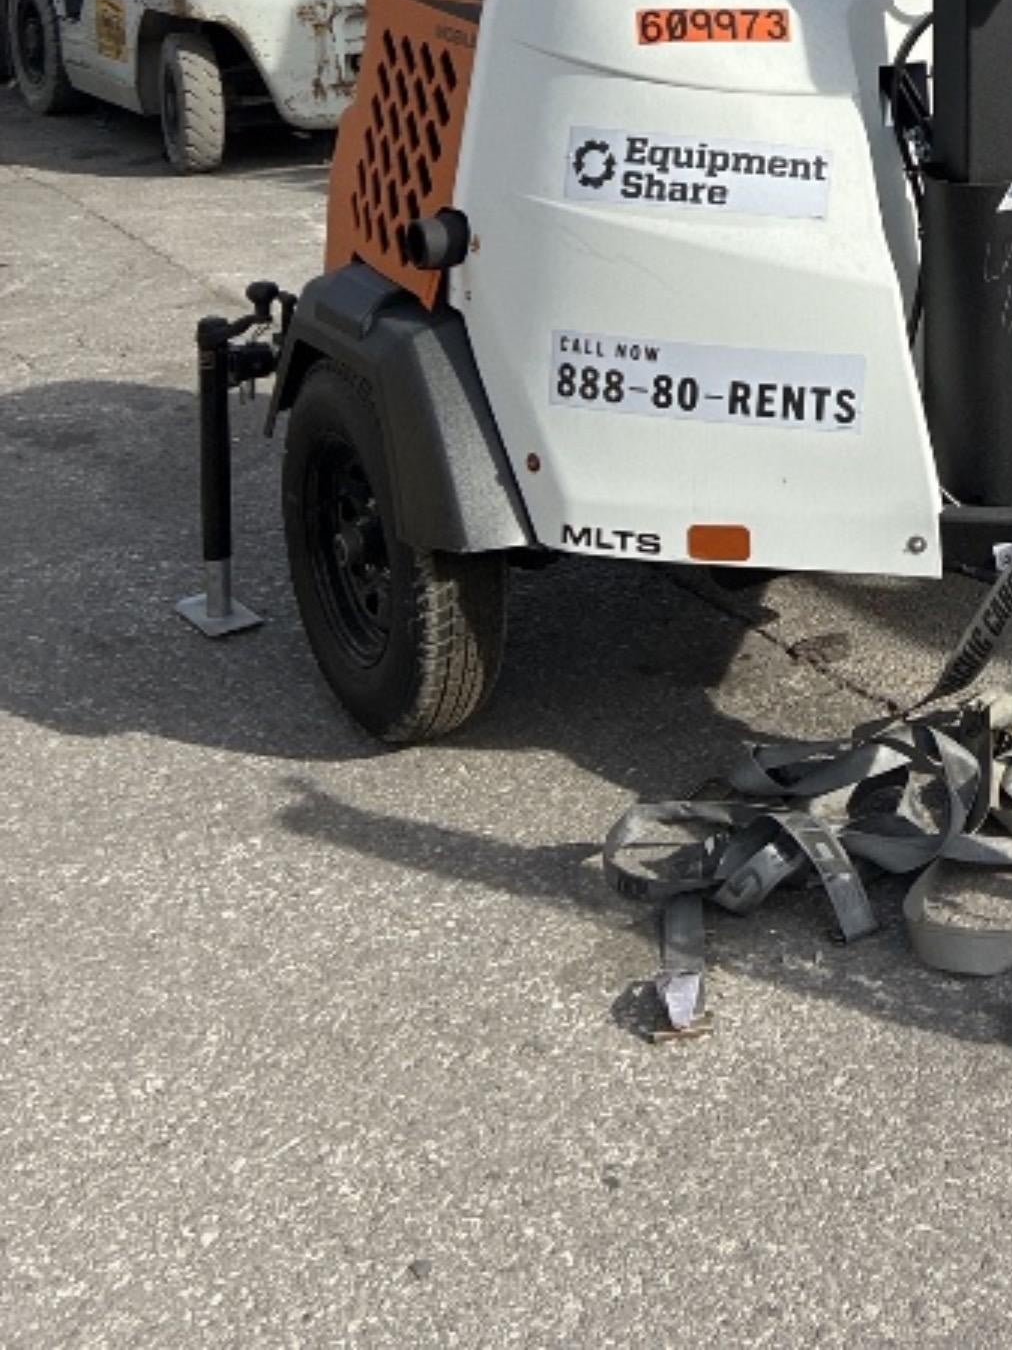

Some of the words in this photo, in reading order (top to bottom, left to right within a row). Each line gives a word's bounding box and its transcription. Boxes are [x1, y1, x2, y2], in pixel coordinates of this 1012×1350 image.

[639, 8, 788, 42] 609973
[624, 136, 828, 181] Equipment
[620, 170, 729, 205] Share
[559, 335, 605, 358] CALL
[614, 342, 661, 362] NOW
[556, 361, 857, 424] 888-80-RENTS
[561, 523, 662, 555] MLTS
